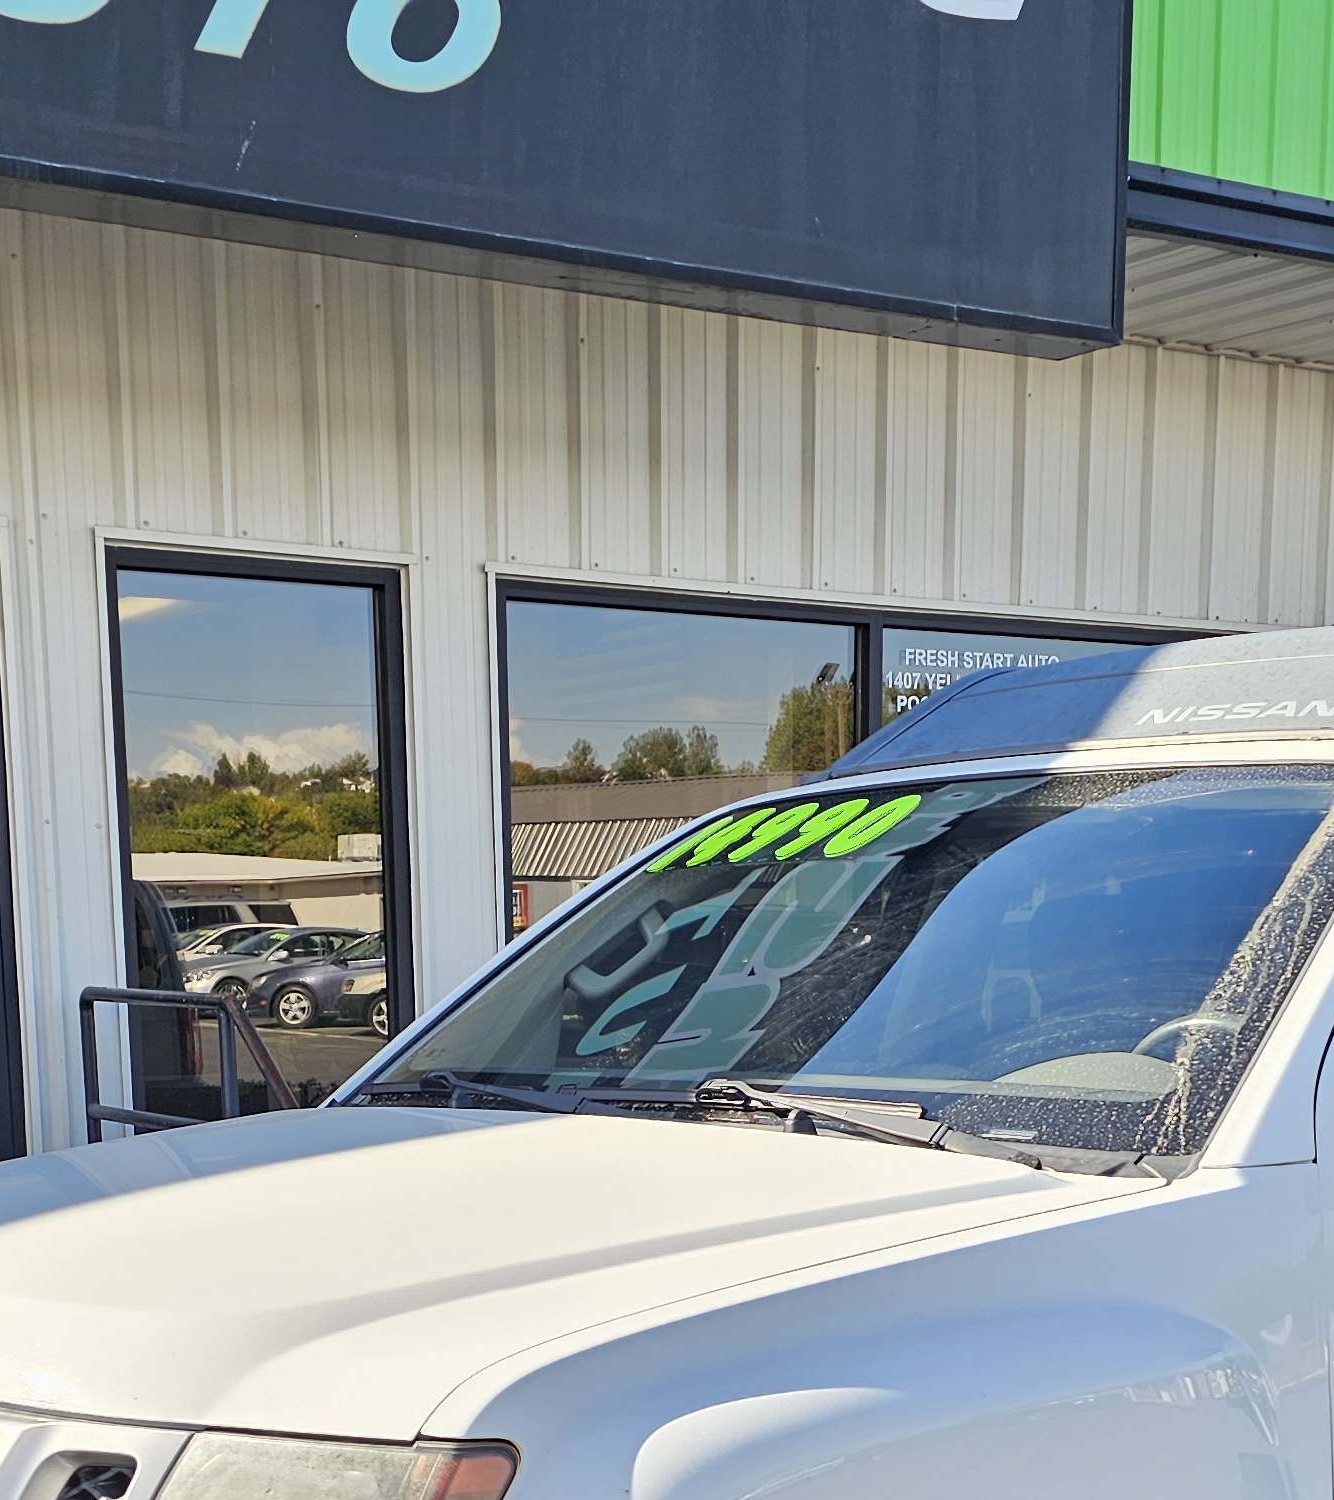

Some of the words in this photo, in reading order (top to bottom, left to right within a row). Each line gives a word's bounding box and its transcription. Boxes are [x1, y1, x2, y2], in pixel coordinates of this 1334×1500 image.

[905, 648, 959, 668] FRESH
[963, 651, 1014, 670] START
[885, 671, 921, 690] 1407
[646, 794, 922, 873] 14990
